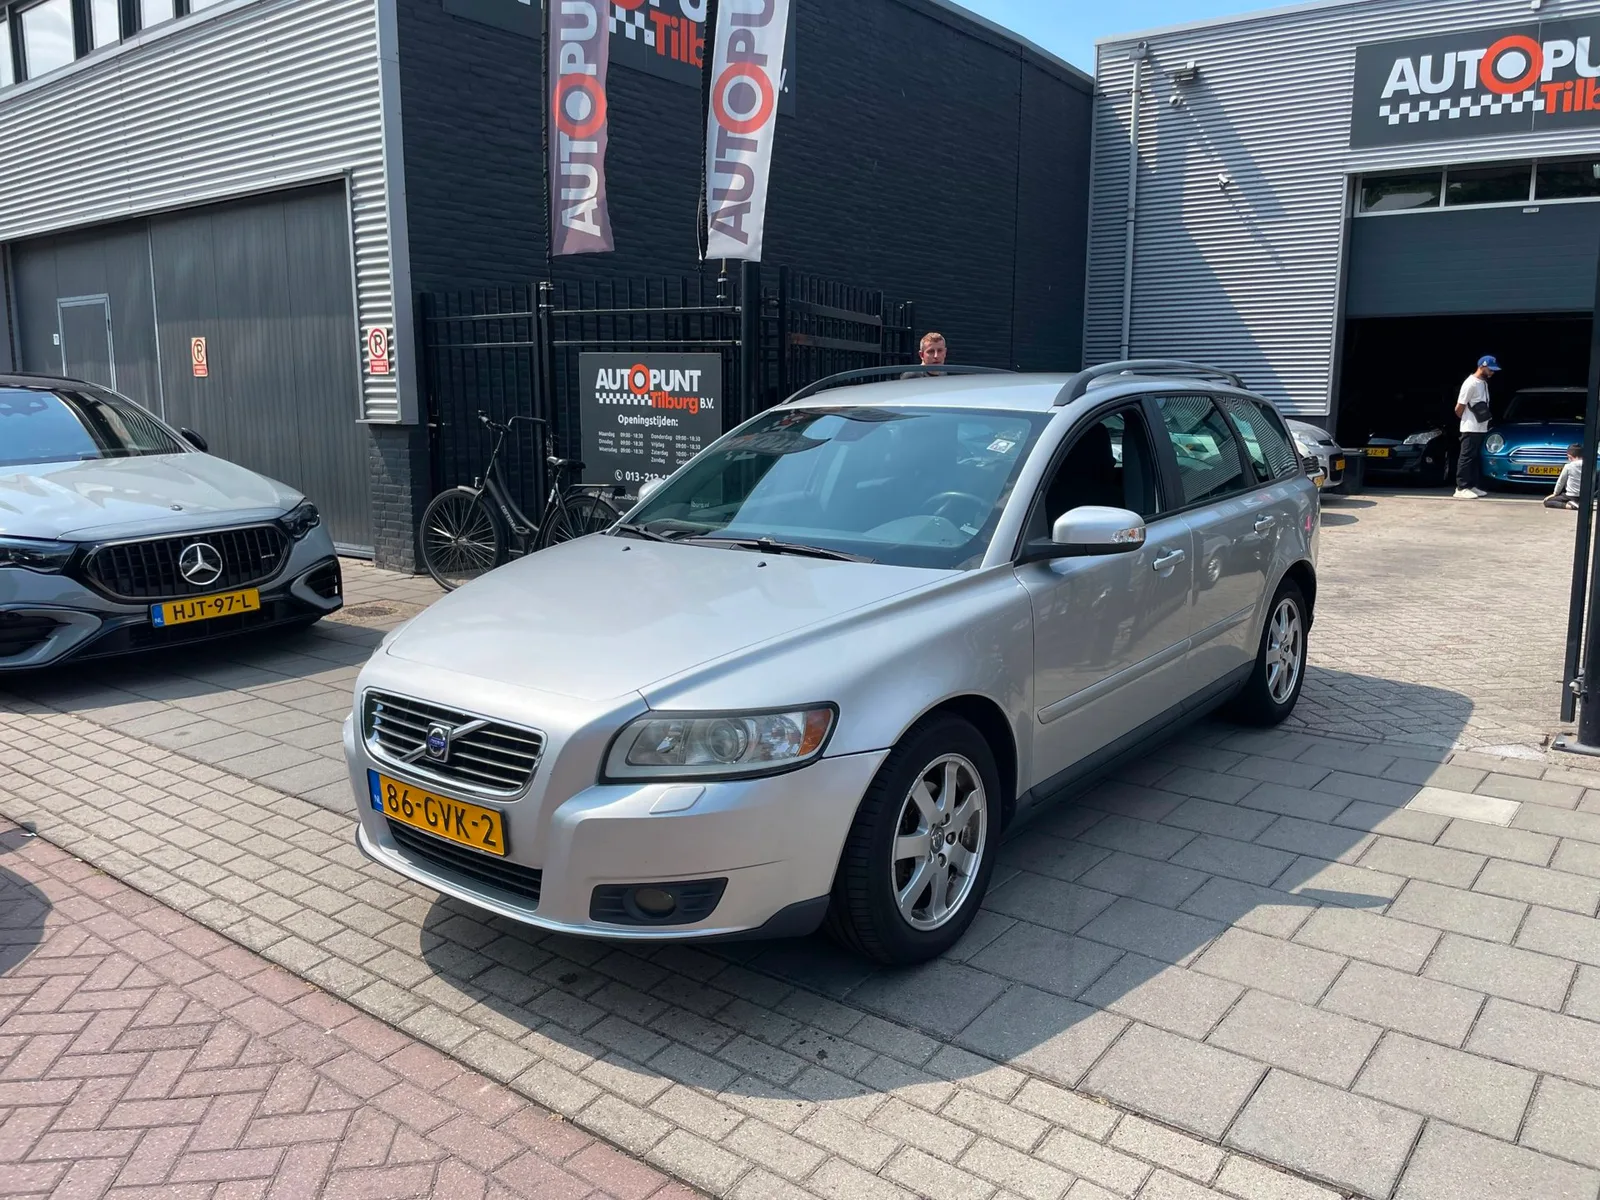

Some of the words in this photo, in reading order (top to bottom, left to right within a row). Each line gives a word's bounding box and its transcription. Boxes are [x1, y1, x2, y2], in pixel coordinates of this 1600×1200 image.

[596, 364, 702, 395] AUTOPUNT
[650, 391, 699, 414] Tilburg
[700, 398, 714, 409] B.V.
[618, 414, 678, 427] Openingstijden:
[173, 594, 251, 620] HJT-97-L
[387, 784, 497, 847] 86-GVK-2
